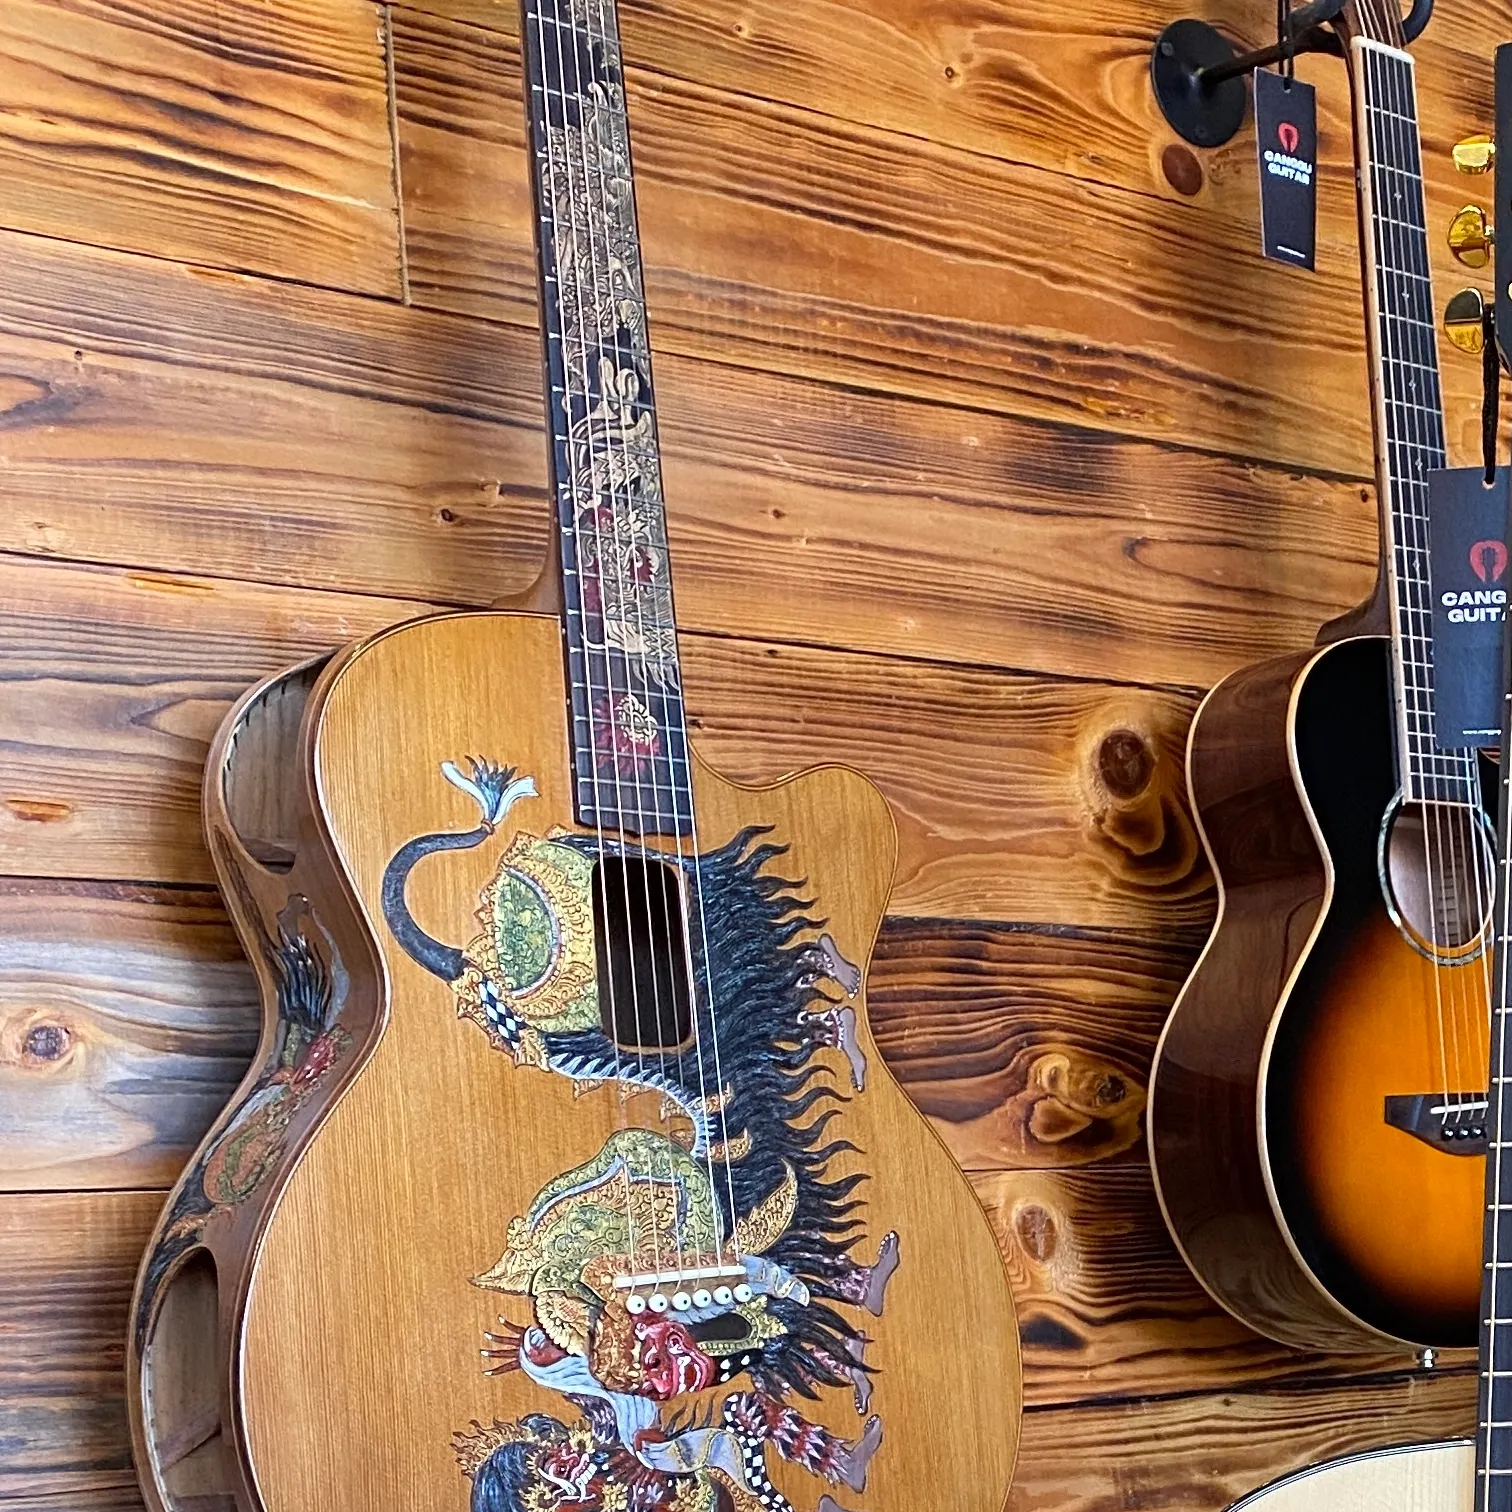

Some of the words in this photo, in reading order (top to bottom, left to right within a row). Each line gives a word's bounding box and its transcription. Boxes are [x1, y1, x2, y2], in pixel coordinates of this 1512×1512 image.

[1267, 162, 1310, 185] GUITAR
[1441, 590, 1507, 607] CANG
[1447, 607, 1506, 623] GUIT
